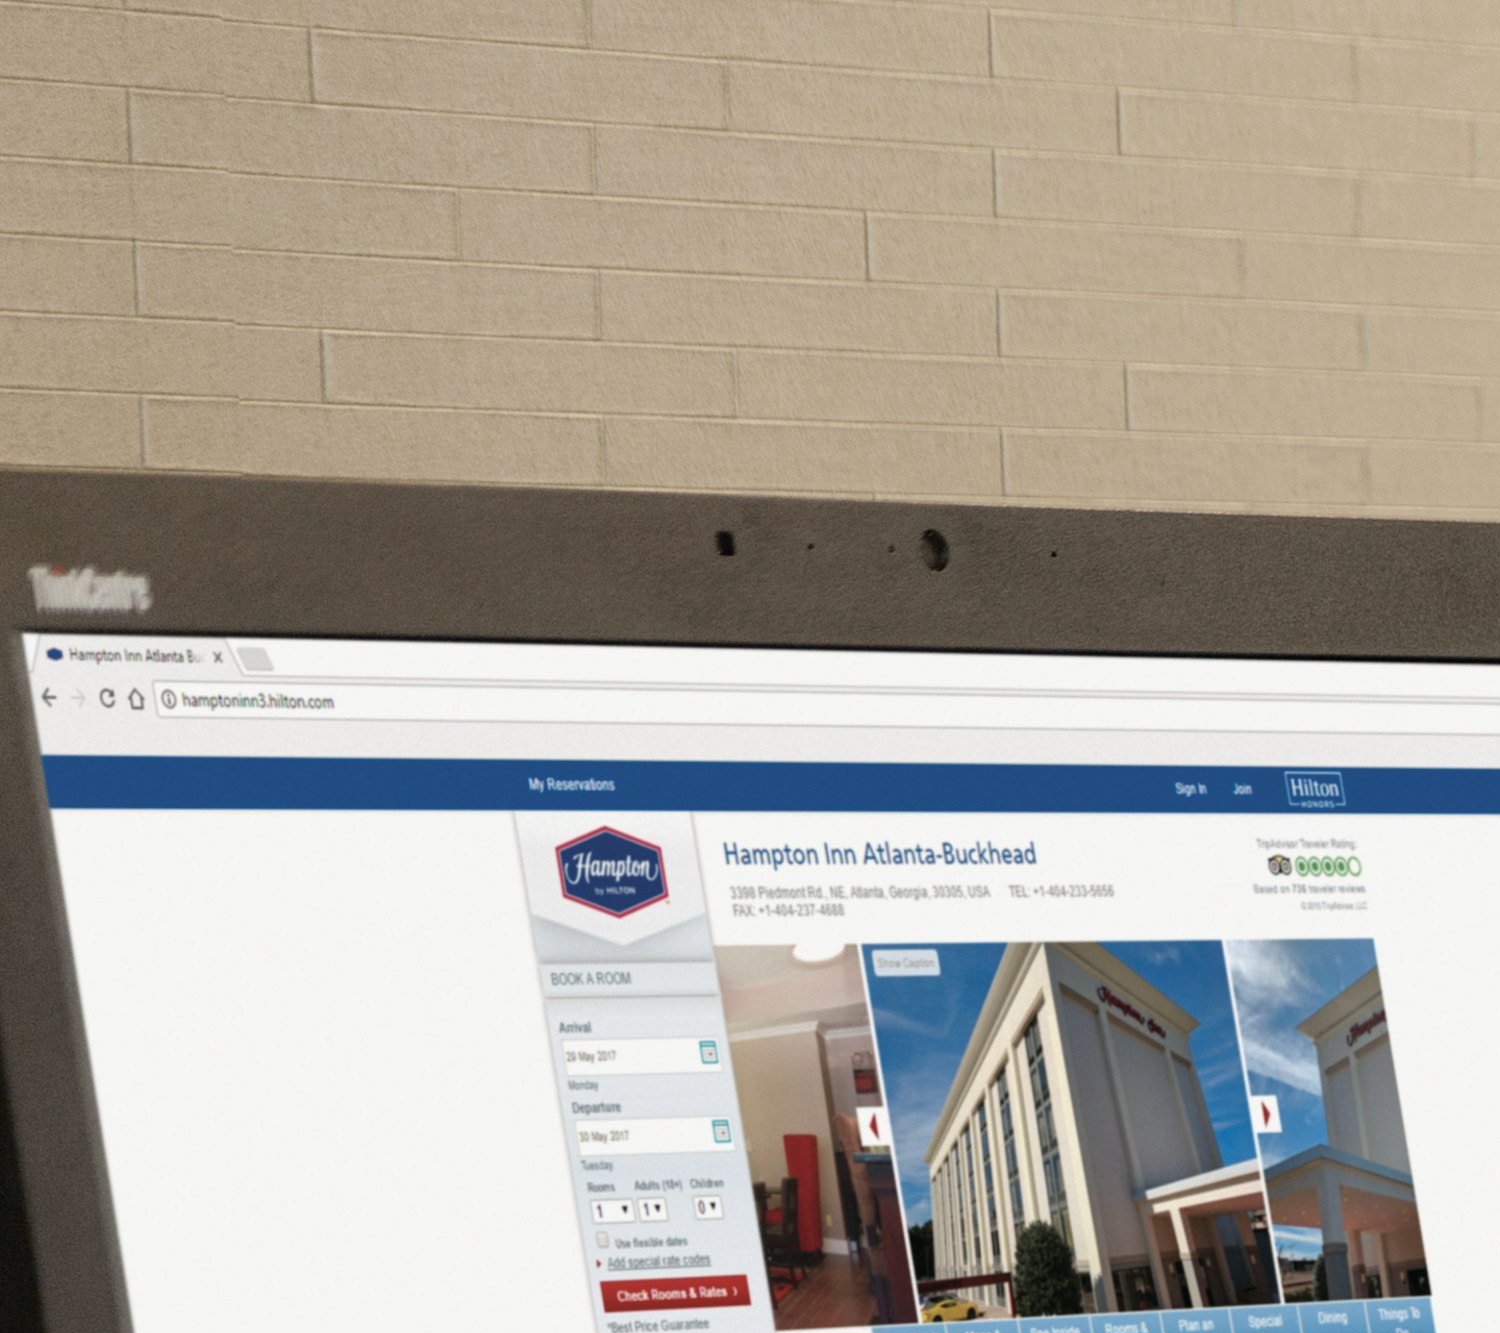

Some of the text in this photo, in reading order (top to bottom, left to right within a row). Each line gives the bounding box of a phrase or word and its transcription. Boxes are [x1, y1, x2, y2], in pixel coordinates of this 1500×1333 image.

[68, 647, 122, 665] Hampton
[123, 648, 143, 662] Inn
[144, 648, 185, 664] Atlanta
[181, 692, 335, 711] hamptoninn3.hilton.com
[528, 777, 615, 792] My Reservations
[1175, 781, 1207, 797] Sign In
[1233, 783, 1253, 795] Join
[1290, 778, 1339, 796] Hilton
[722, 840, 1037, 871] Hampton Inn Atlanta-Buckhead
[562, 851, 661, 885] Hampton
[549, 970, 632, 986] BOOK A ROOM
[558, 1021, 593, 1033] Arrival
[566, 1079, 599, 1093] Monday
[570, 1101, 622, 1116] Departure
[580, 1159, 614, 1172] Tuesday
[688, 1177, 725, 1189] Children
[596, 1203, 603, 1219] 1
[642, 1202, 650, 1217] 1
[697, 1199, 706, 1215] 0
[614, 1236, 689, 1249] Use flexible dates
[607, 1253, 712, 1271] Add special rate codes
[616, 1285, 728, 1302] Check Rooms & Rates
[1317, 1311, 1348, 1325] Dining
[1377, 1305, 1421, 1322] Things To
[633, 1319, 659, 1333] Price
[659, 1317, 710, 1332] Guarantee
[1140, 1321, 1148, 1333] &
[1177, 1318, 1214, 1331] Plan an
[1247, 1315, 1283, 1329] Special
